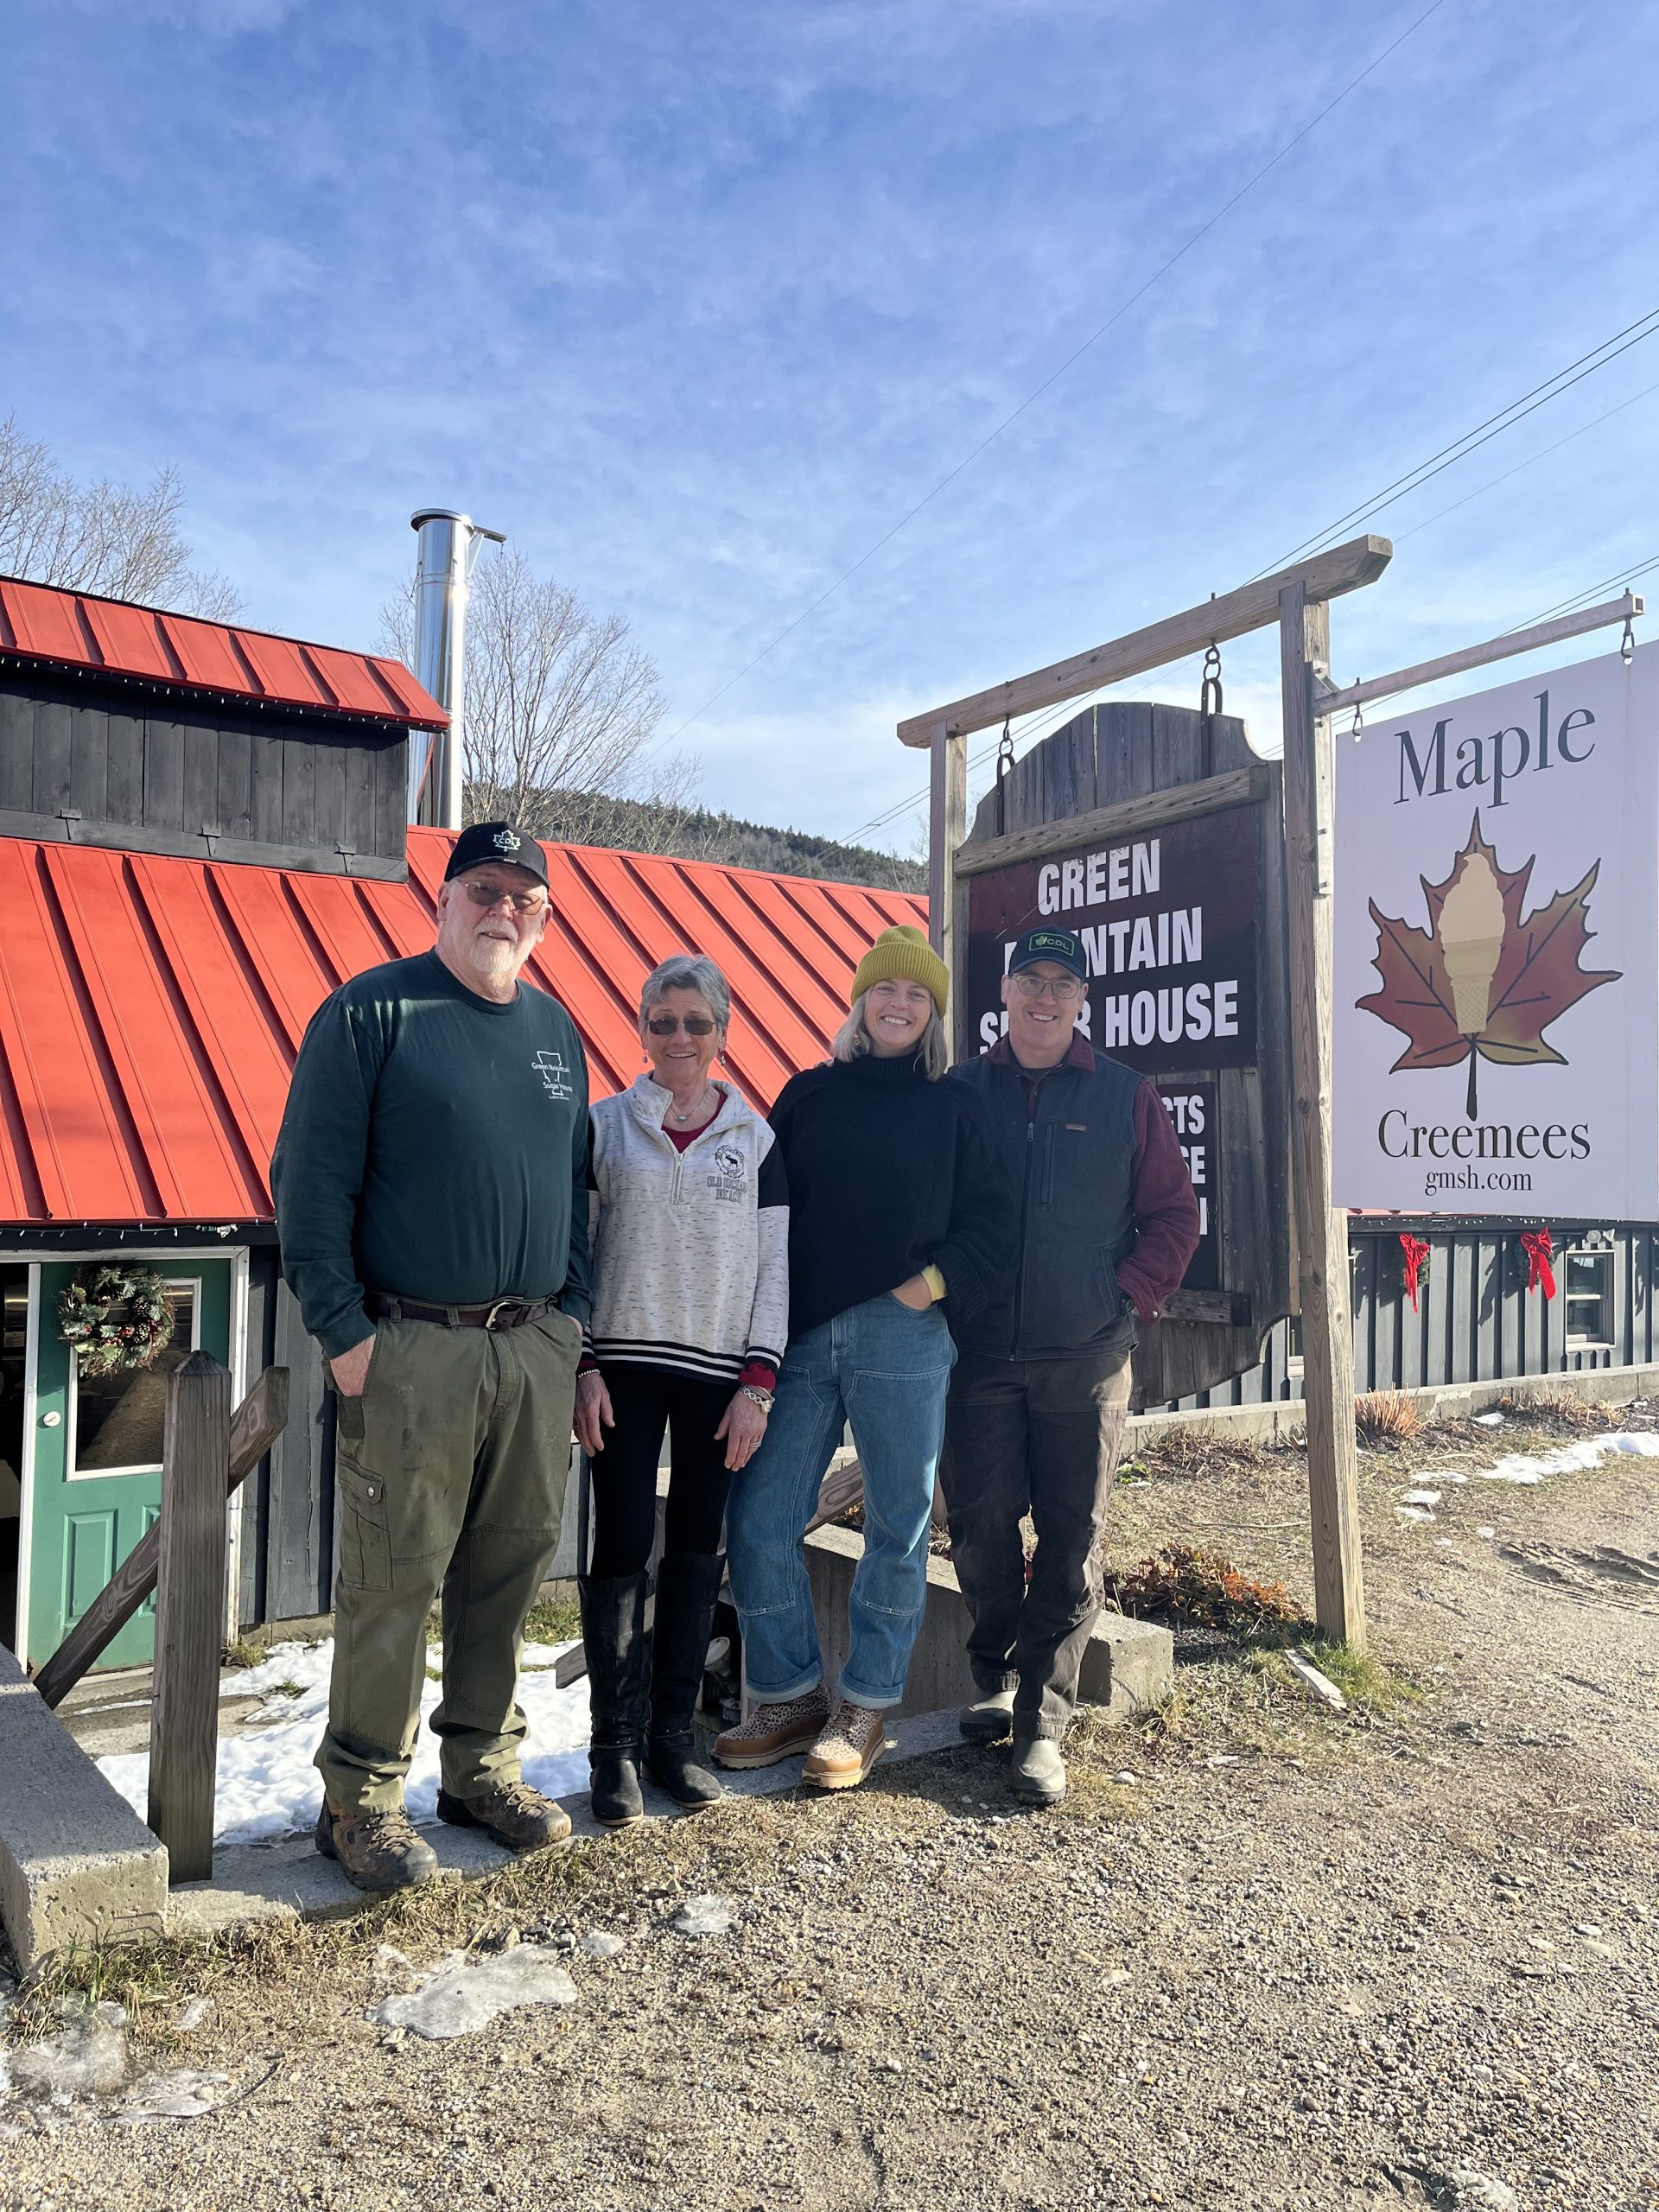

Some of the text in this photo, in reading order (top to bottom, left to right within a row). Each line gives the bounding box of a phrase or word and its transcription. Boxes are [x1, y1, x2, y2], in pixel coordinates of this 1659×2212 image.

[1393, 690, 1596, 809] Maple
[1038, 838, 1160, 916] GREEN
[1004, 906, 1202, 978] NTAIN
[1046, 938, 1070, 950] CDL
[1105, 979, 1239, 1048] HOUSE
[1378, 1109, 1591, 1160] Creemees
[1425, 1165, 1534, 1197] gmsh.com
